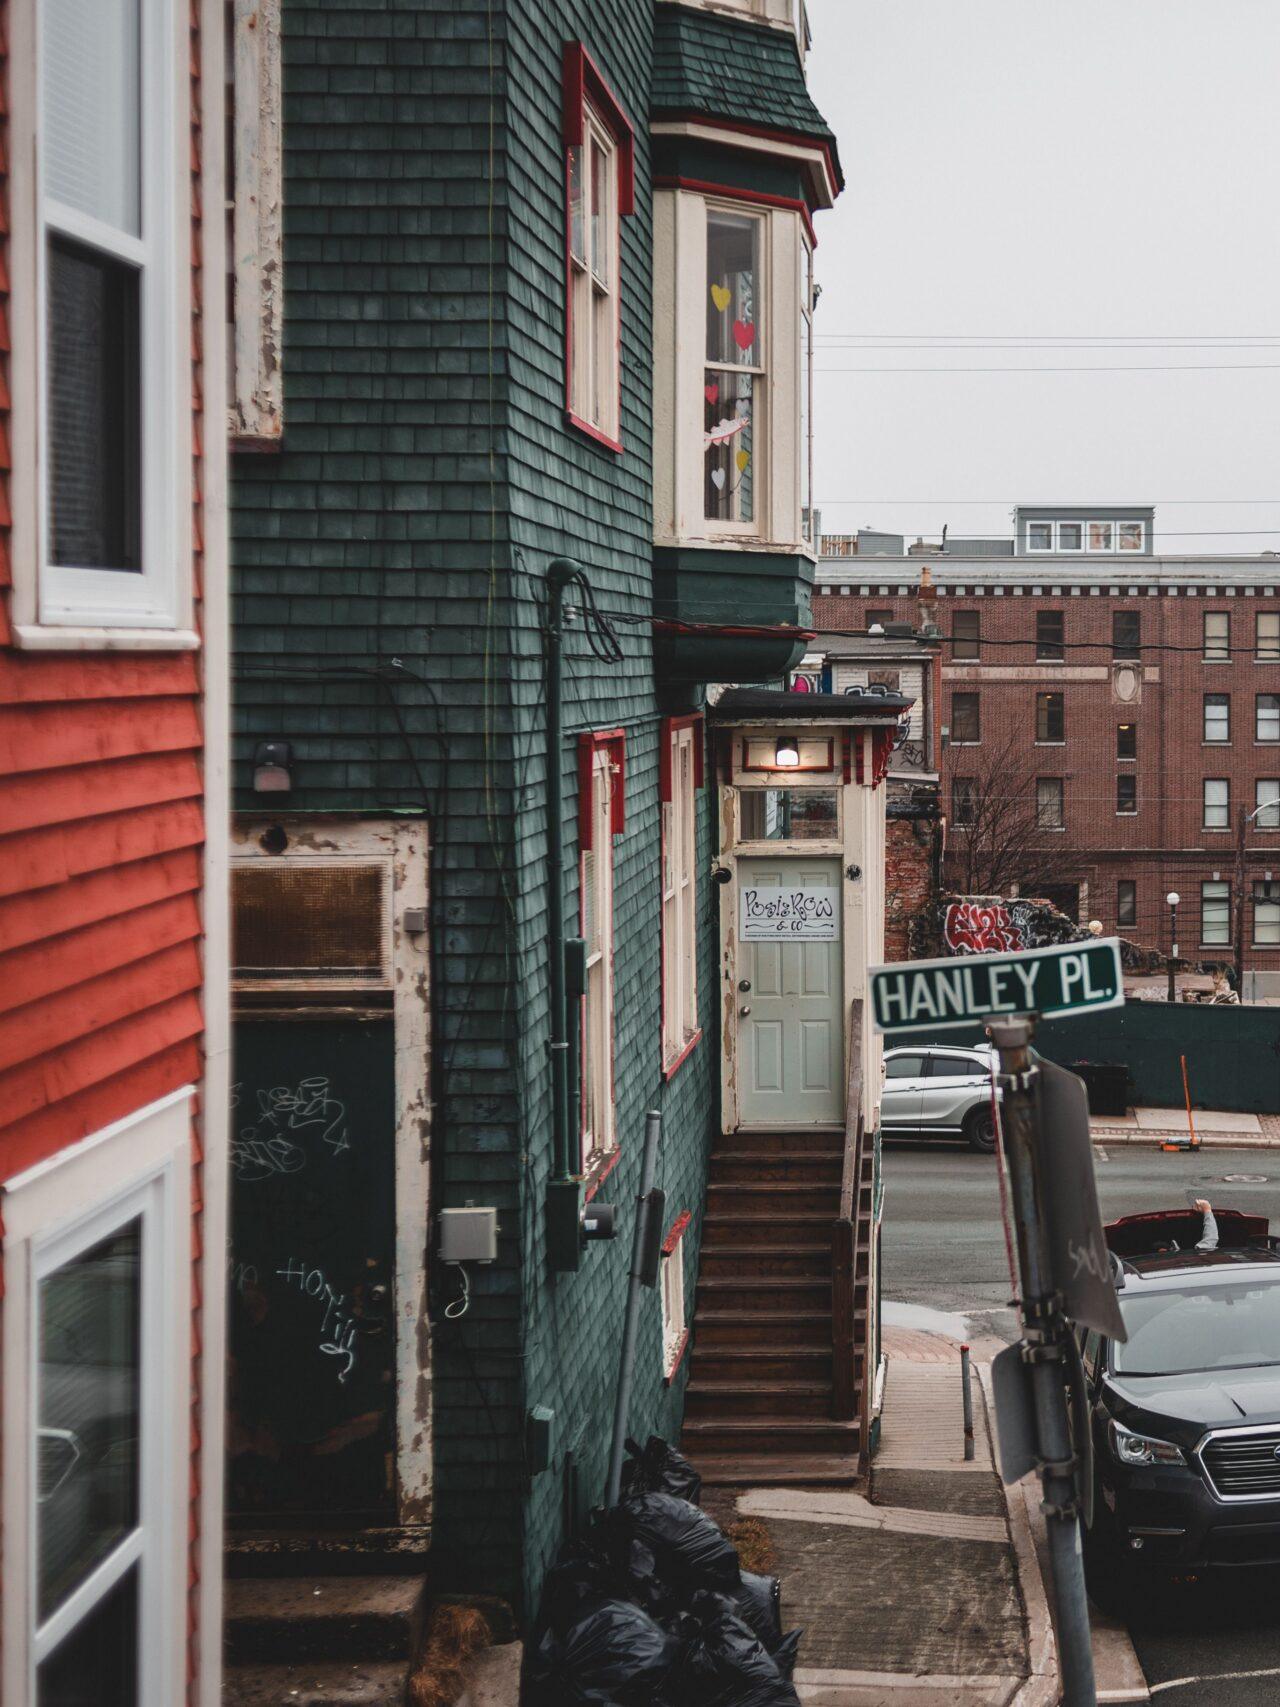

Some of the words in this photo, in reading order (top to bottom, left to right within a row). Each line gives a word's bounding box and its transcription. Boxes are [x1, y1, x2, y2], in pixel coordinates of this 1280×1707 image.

[776, 920, 788, 931] &
[878, 960, 1040, 1021] HANLEY
[1059, 952, 1113, 1005] PL.
